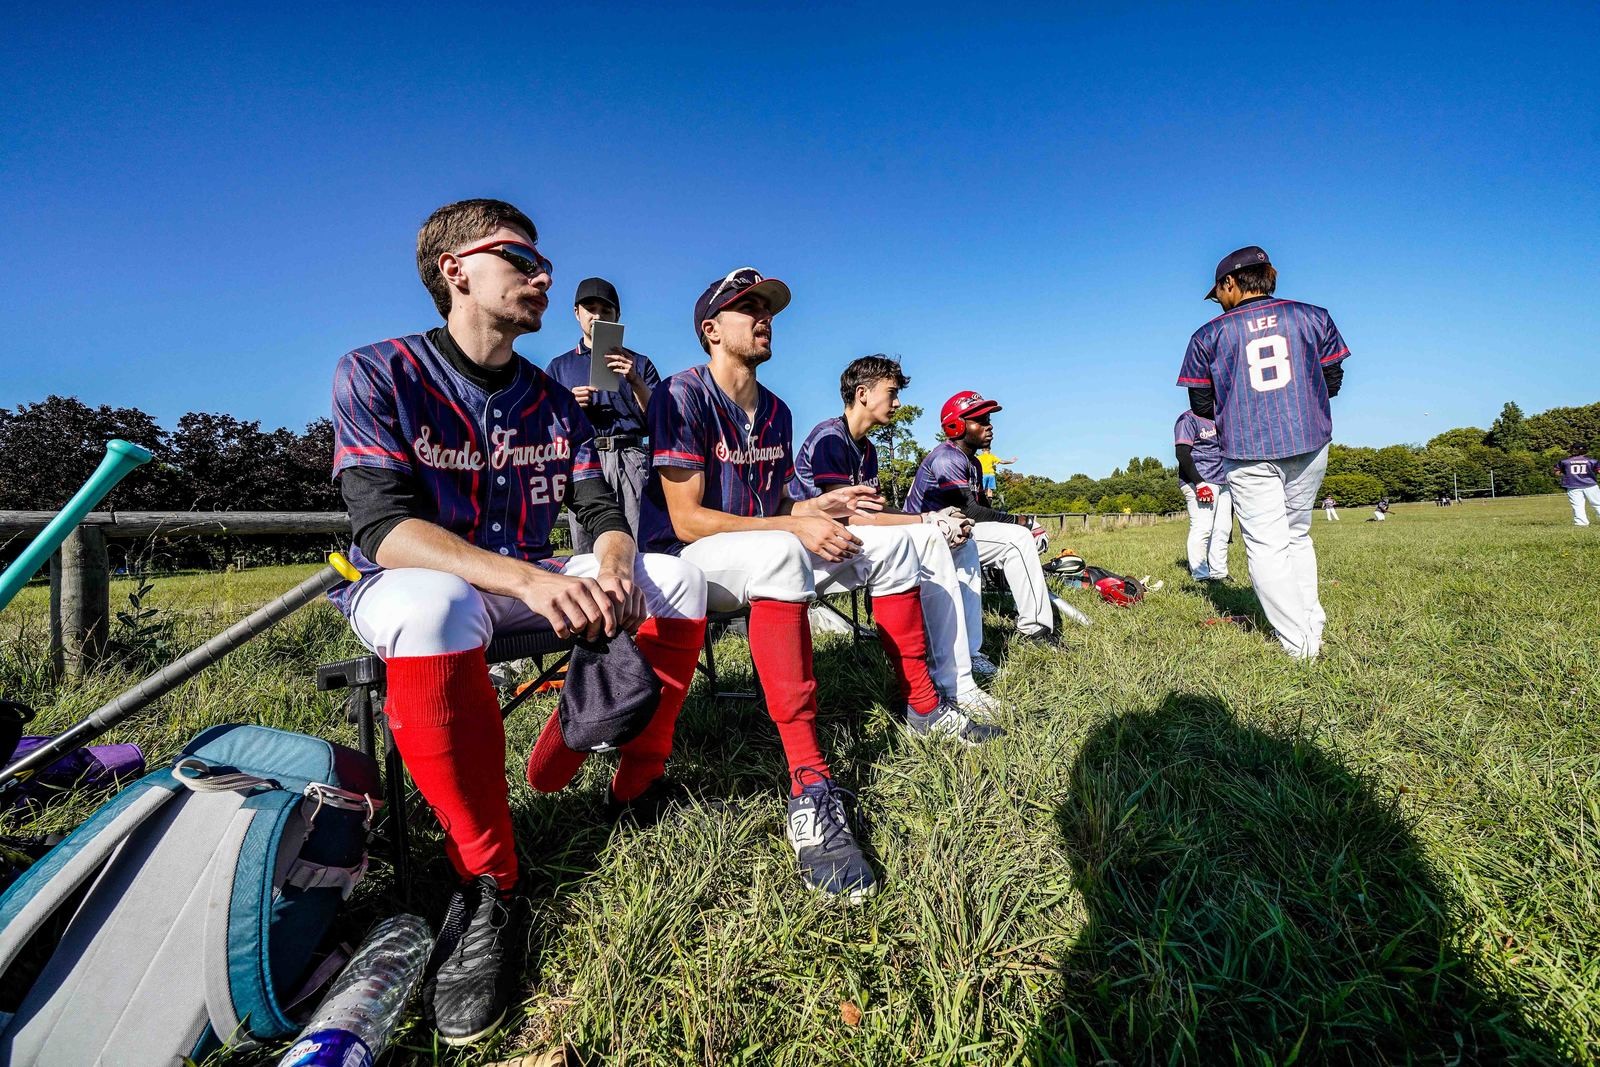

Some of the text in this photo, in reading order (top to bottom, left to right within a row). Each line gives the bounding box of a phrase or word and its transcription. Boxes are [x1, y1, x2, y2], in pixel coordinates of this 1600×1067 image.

[1247, 315, 1278, 332] LEE
[1245, 334, 1292, 392] 8
[414, 425, 485, 471] Stade
[1571, 464, 1587, 475] 01
[529, 474, 568, 505] 26
